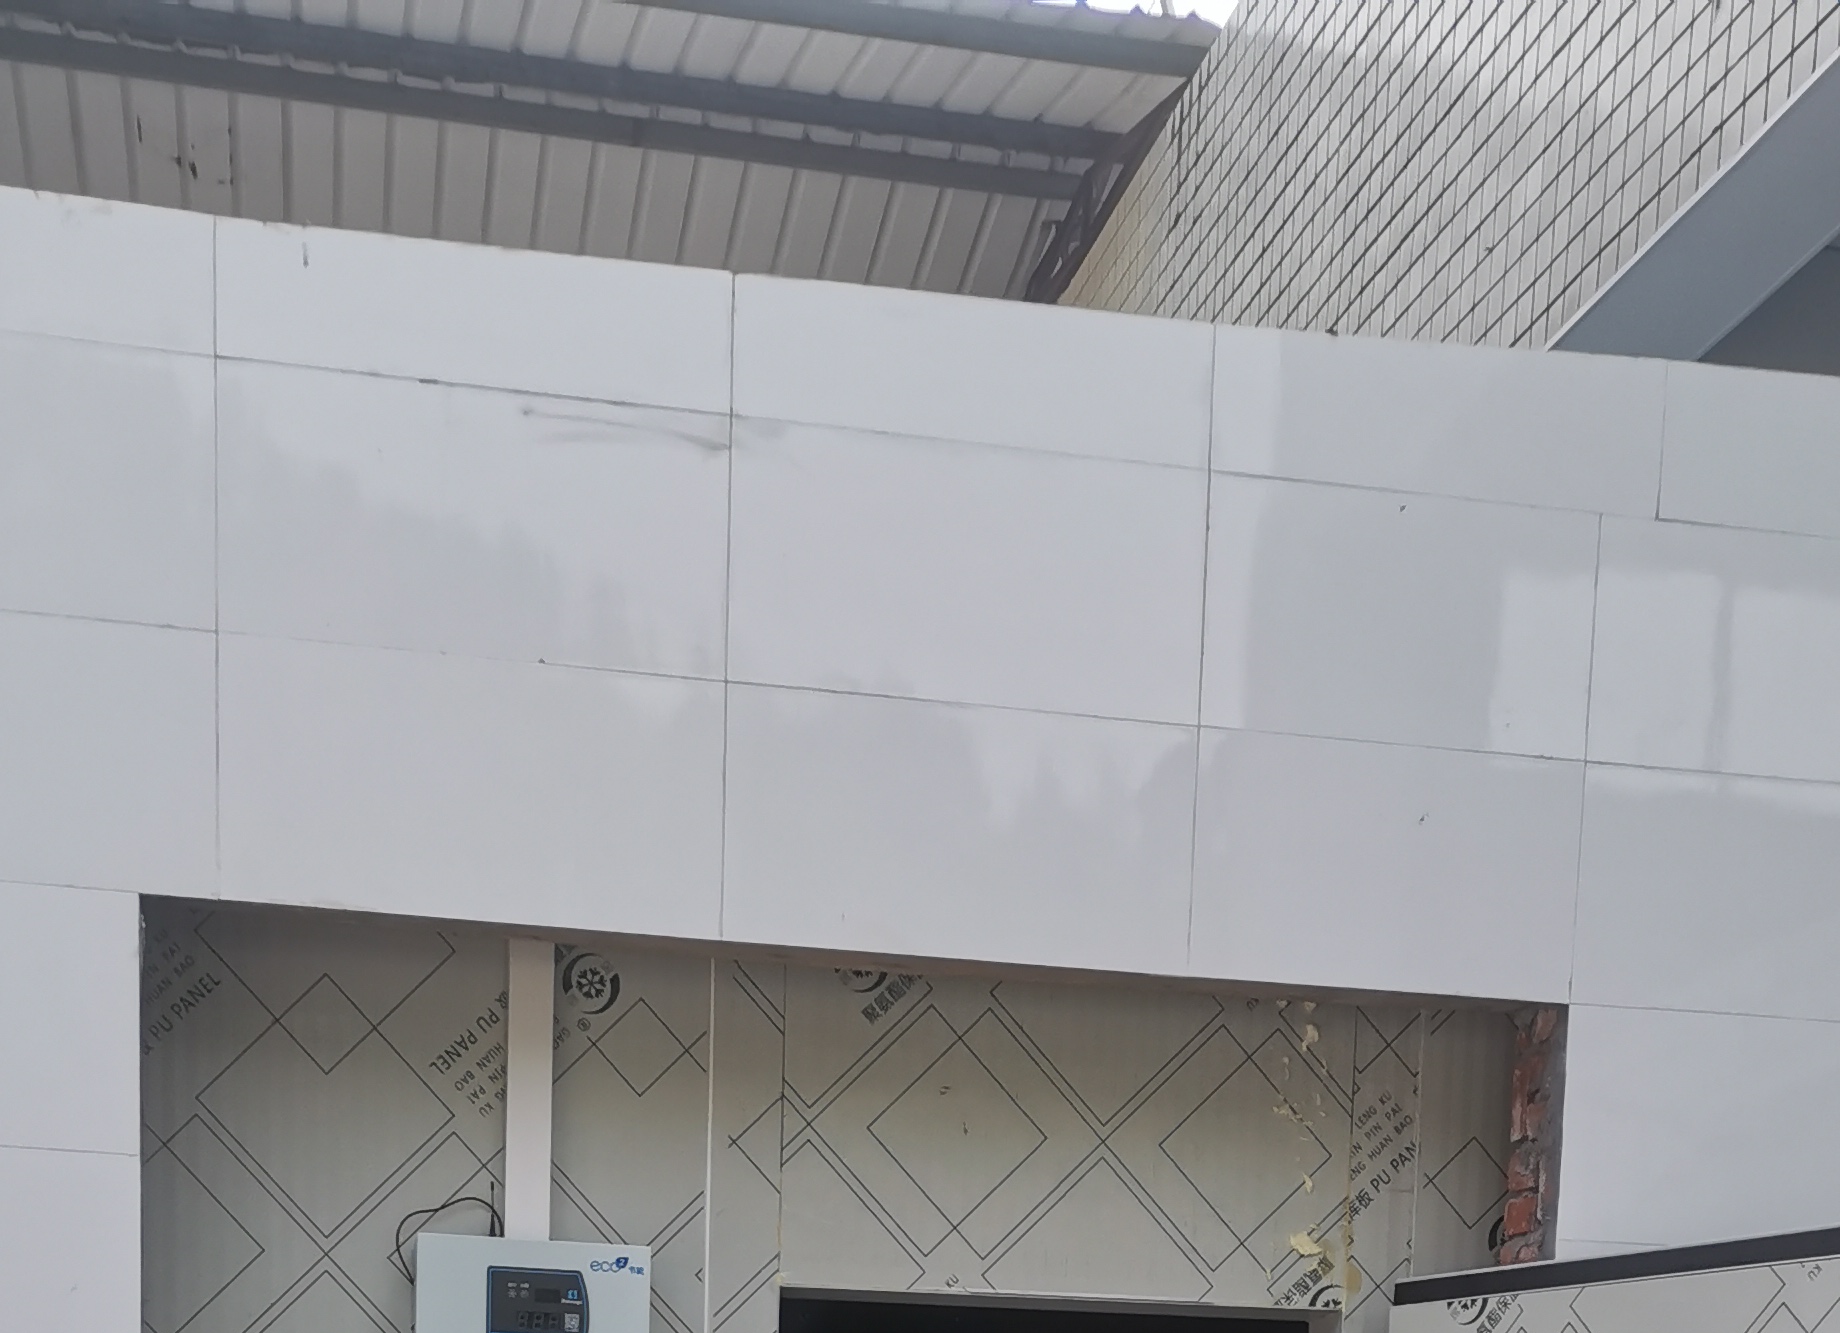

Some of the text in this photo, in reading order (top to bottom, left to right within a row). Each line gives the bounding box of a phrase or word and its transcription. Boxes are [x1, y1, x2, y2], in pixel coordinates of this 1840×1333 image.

[150, 972, 221, 1041] PU PANEL
[429, 1007, 500, 1075] PU PANEL
[454, 1042, 504, 1092] HUAN BAO
[467, 1085, 487, 1105] PAI
[478, 1102, 494, 1118] KU
[1355, 1090, 1392, 1130] LENG KU
[1364, 1103, 1402, 1141] PIN PAI
[1368, 1114, 1413, 1162] HUAN BAO
[1370, 1169, 1391, 1194] PU
[945, 1274, 959, 1288] KU
